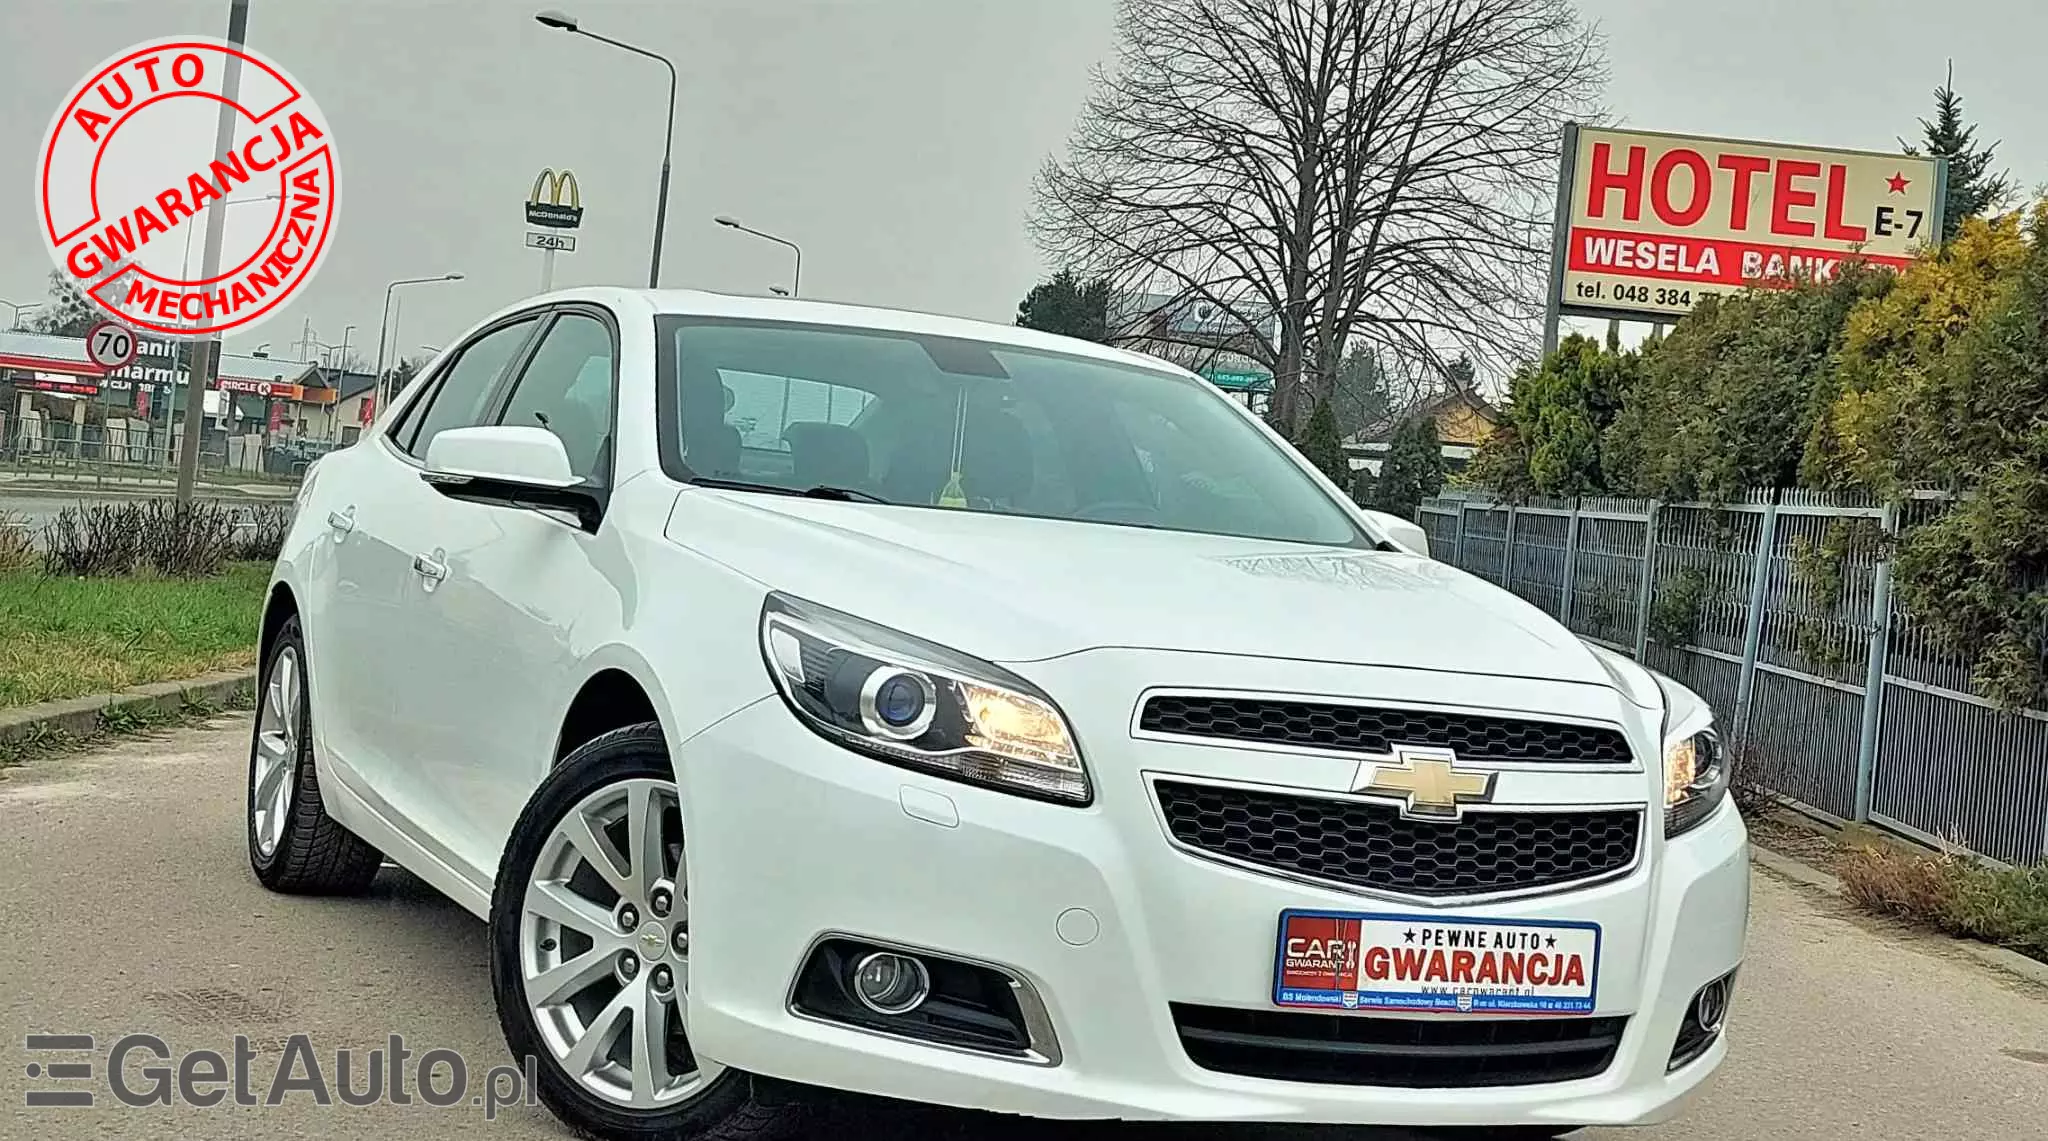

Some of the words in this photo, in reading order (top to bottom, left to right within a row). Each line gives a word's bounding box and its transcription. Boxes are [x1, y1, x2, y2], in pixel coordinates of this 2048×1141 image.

[1586, 142, 1867, 242] HOTEL
[1874, 206, 1924, 239] E-7
[536, 236, 565, 248] 24h
[1585, 236, 1720, 276] WESELA
[1576, 282, 1606, 300] tel.
[1613, 284, 1648, 303] 048
[1655, 288, 1691, 306] 384
[98, 333, 129, 358] 70
[221, 380, 257, 393] CIRCLE
[1287, 938, 1345, 959] CAR
[1422, 929, 1487, 948] PEWNE
[1494, 932, 1540, 949] AUTO
[1364, 947, 1585, 987] GWARANCJA
